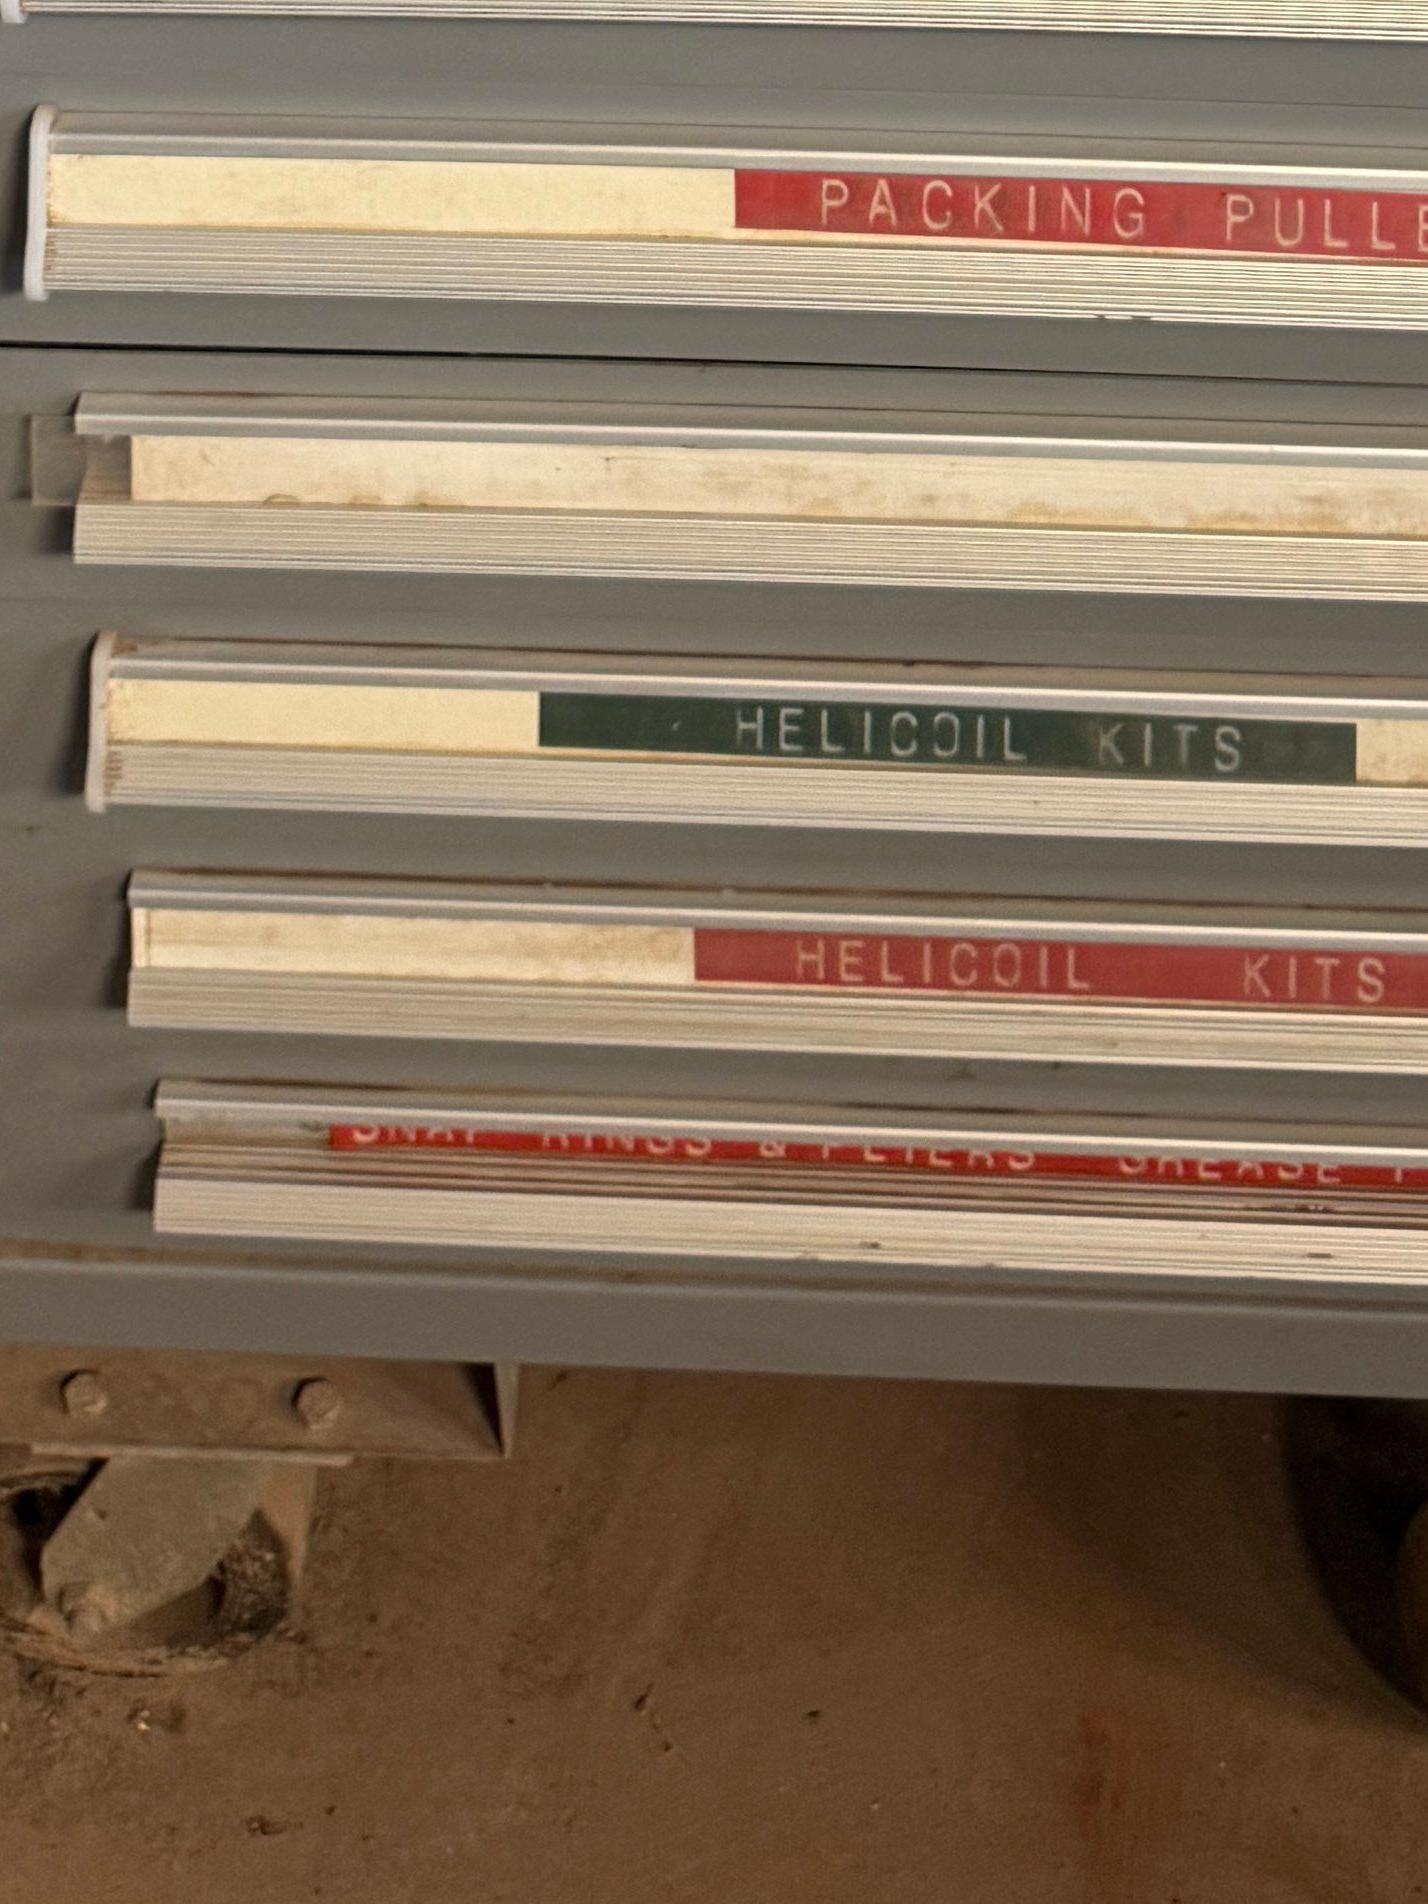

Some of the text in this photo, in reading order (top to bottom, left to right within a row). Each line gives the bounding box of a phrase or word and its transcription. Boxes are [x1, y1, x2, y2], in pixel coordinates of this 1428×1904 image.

[819, 178, 1148, 239] PACKING
[734, 707, 1243, 772] HELICOIL KITS
[795, 937, 1388, 1004] HELICOIL KITS
